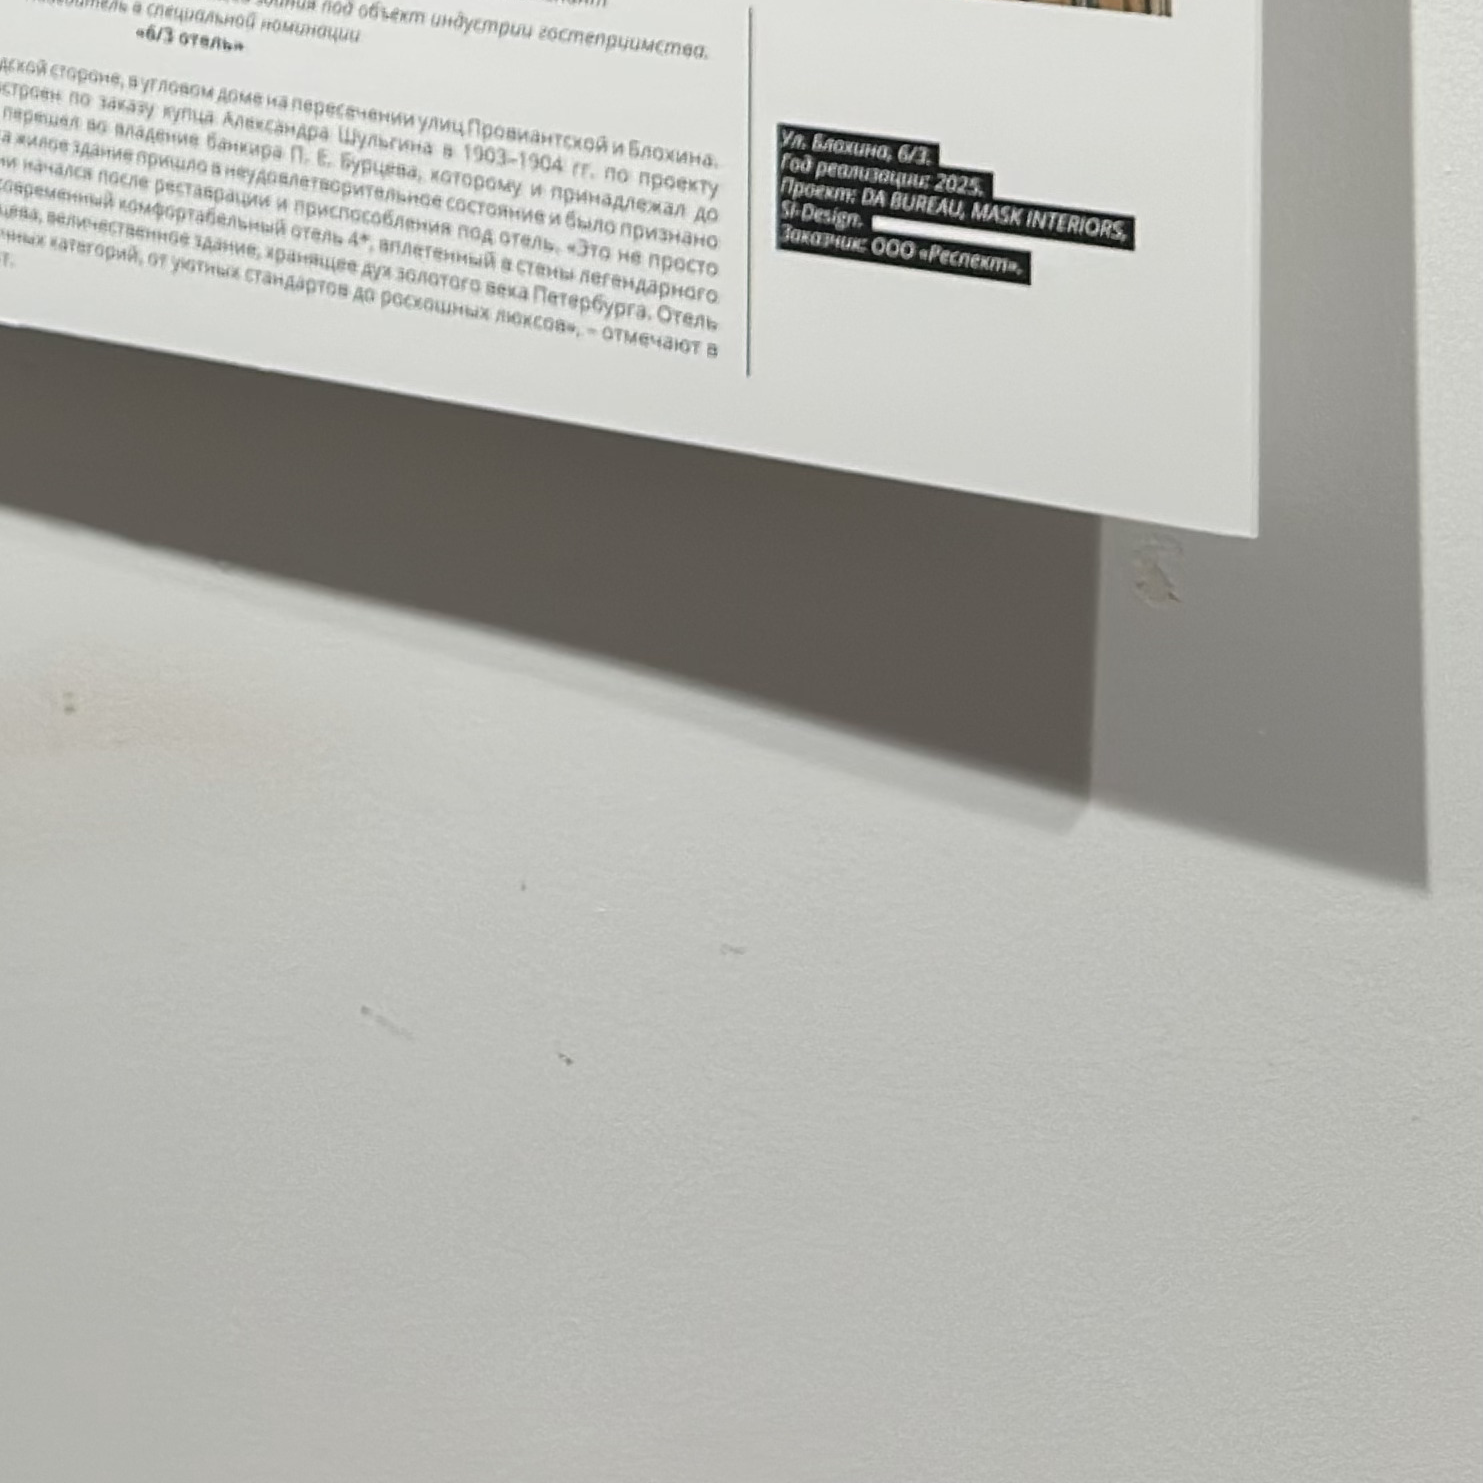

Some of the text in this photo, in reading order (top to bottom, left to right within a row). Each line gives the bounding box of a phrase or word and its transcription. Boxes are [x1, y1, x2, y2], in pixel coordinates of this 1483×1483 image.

[177, 31, 244, 53] отель»
[778, 176, 1128, 245] Проект: DA BUREAU, MASK INTERIORS,
